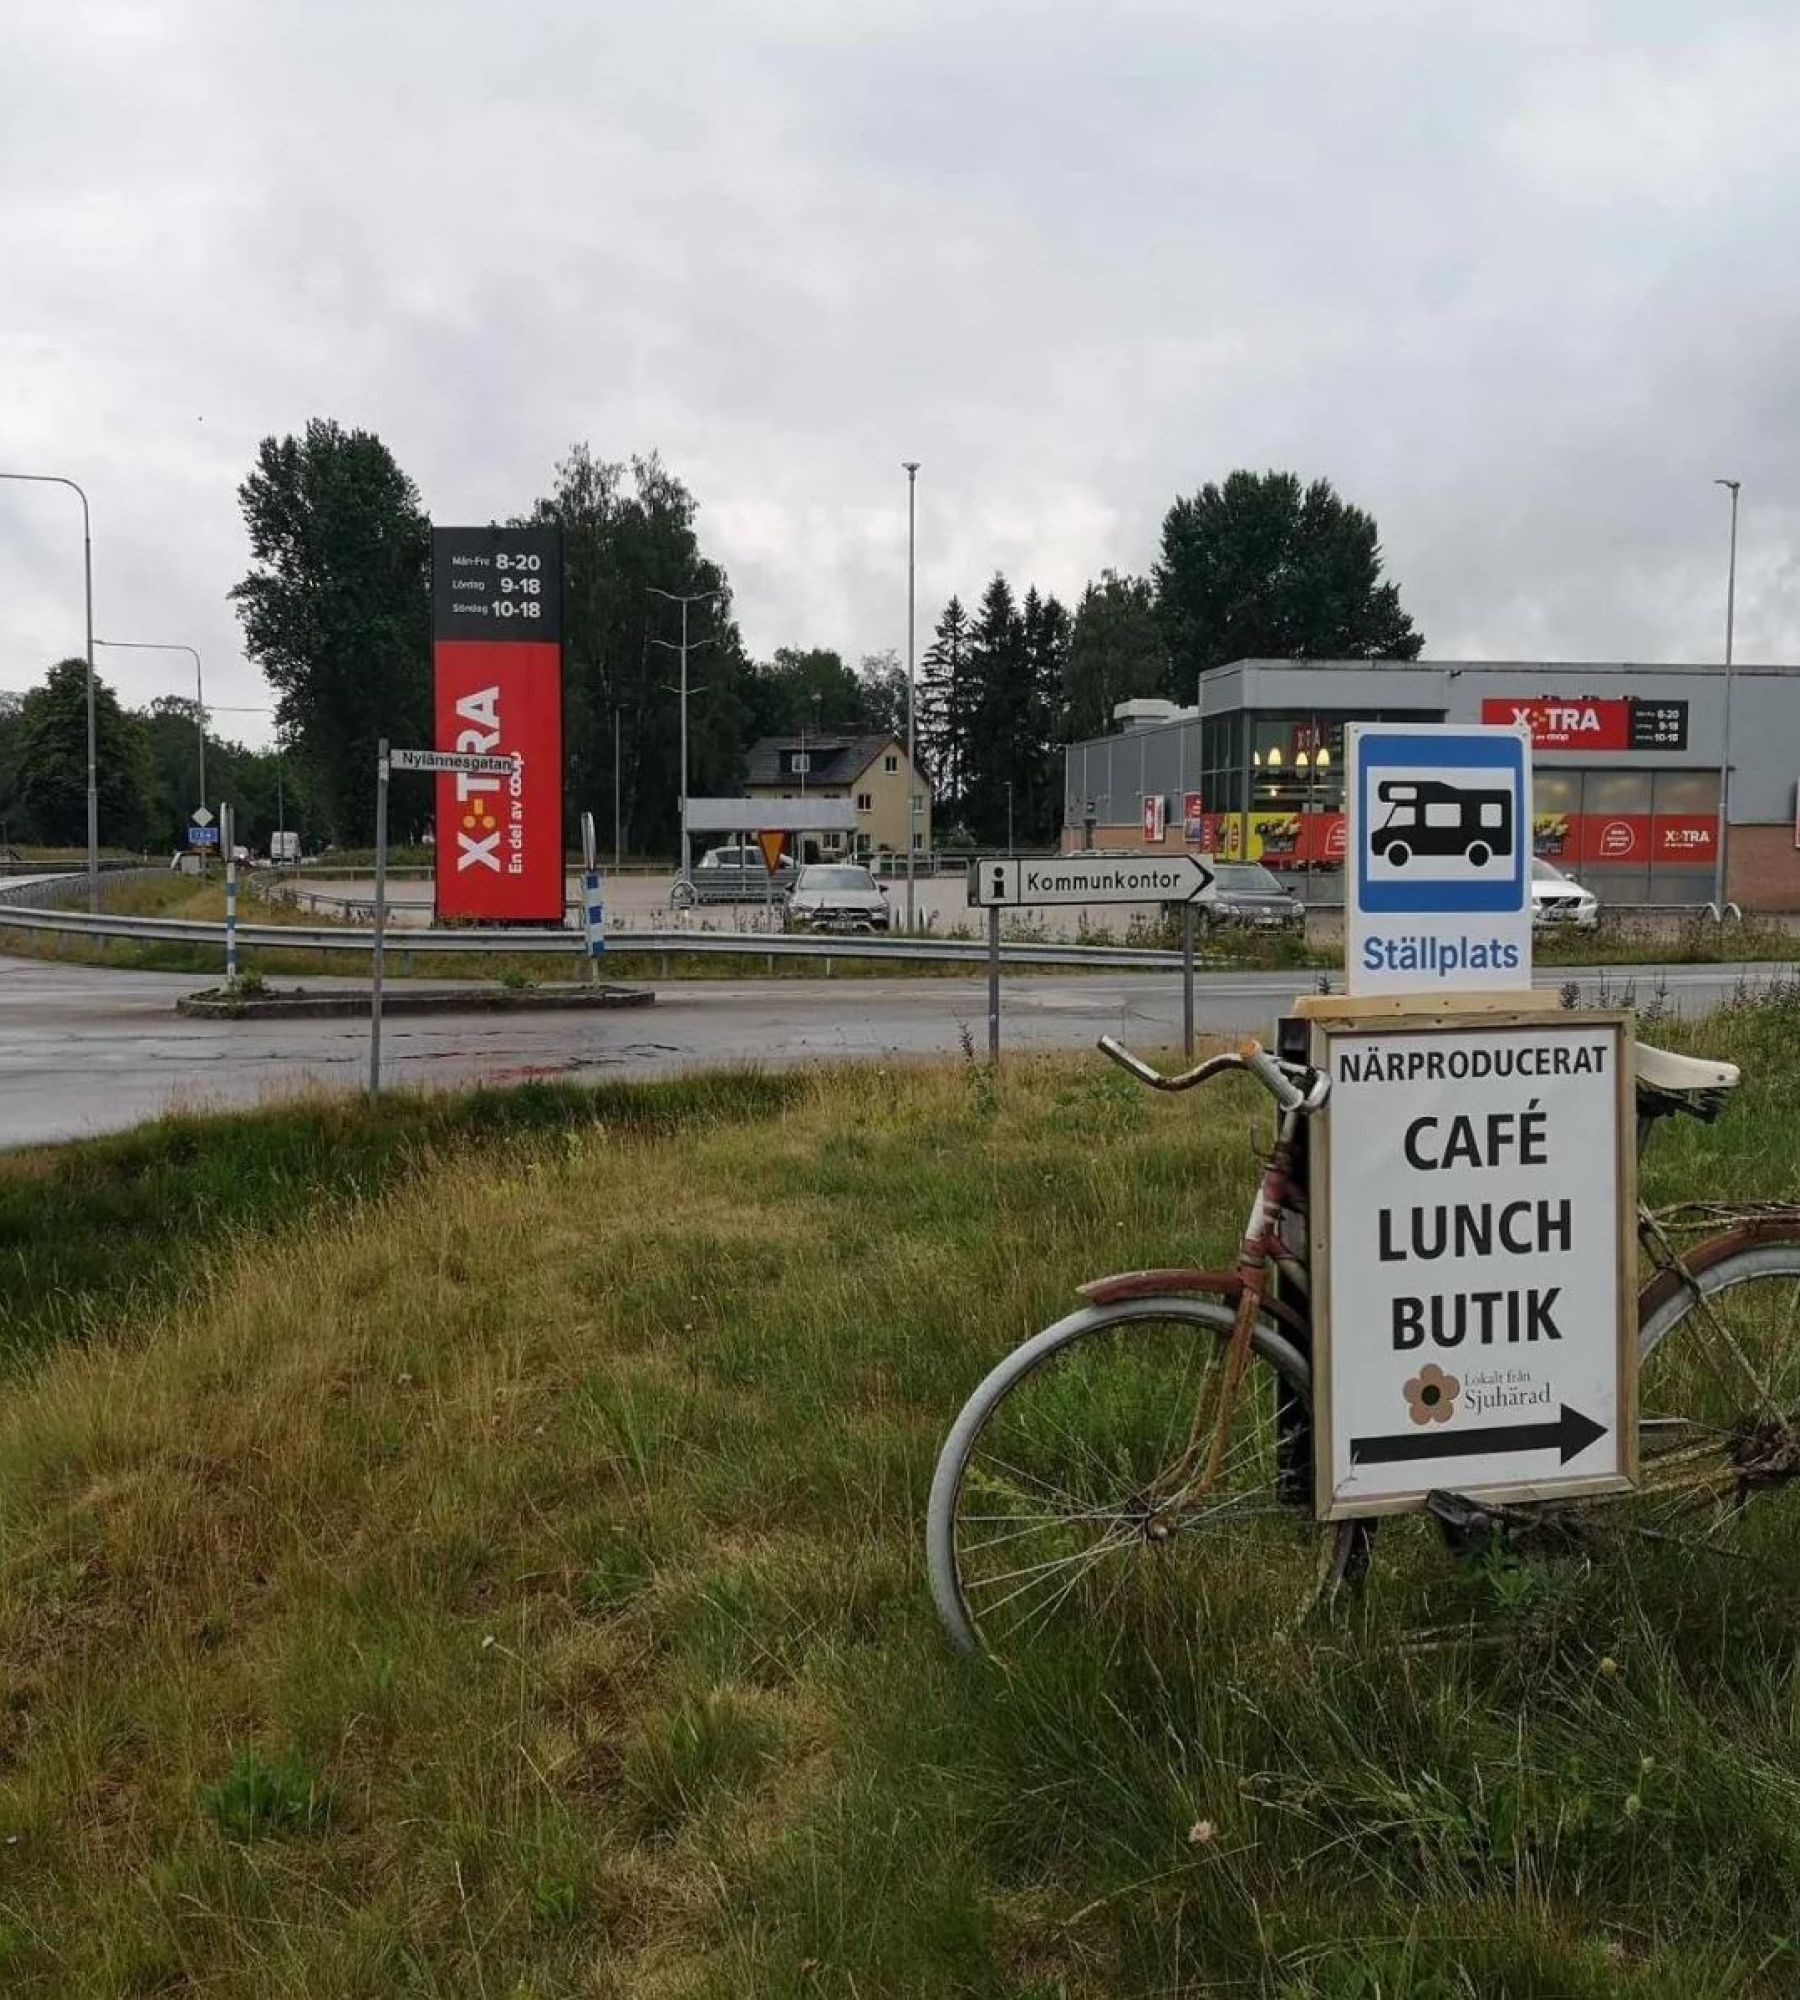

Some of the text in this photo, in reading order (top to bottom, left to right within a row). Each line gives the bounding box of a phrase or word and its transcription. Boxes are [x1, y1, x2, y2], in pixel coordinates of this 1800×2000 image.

[496, 554, 541, 571] 8-20
[500, 577, 540, 594] 9-18
[492, 601, 541, 618] 10-18
[402, 751, 512, 772] Nylännesgatan
[511, 802, 523, 821] av
[508, 825, 523, 849] del
[508, 853, 522, 874] En
[1027, 870, 1181, 892] Kommunkontor
[1363, 936, 1519, 977] Ställplats
[1339, 1046, 1608, 1083] NÄRPRODUCERAT
[1404, 1098, 1548, 1171] CAFÉ
[1379, 1199, 1572, 1262] LUNCH
[1392, 1287, 1562, 1351] BUTIK
[1464, 1369, 1532, 1386] Lokalt från
[1465, 1382, 1551, 1416] Sjuhärad
